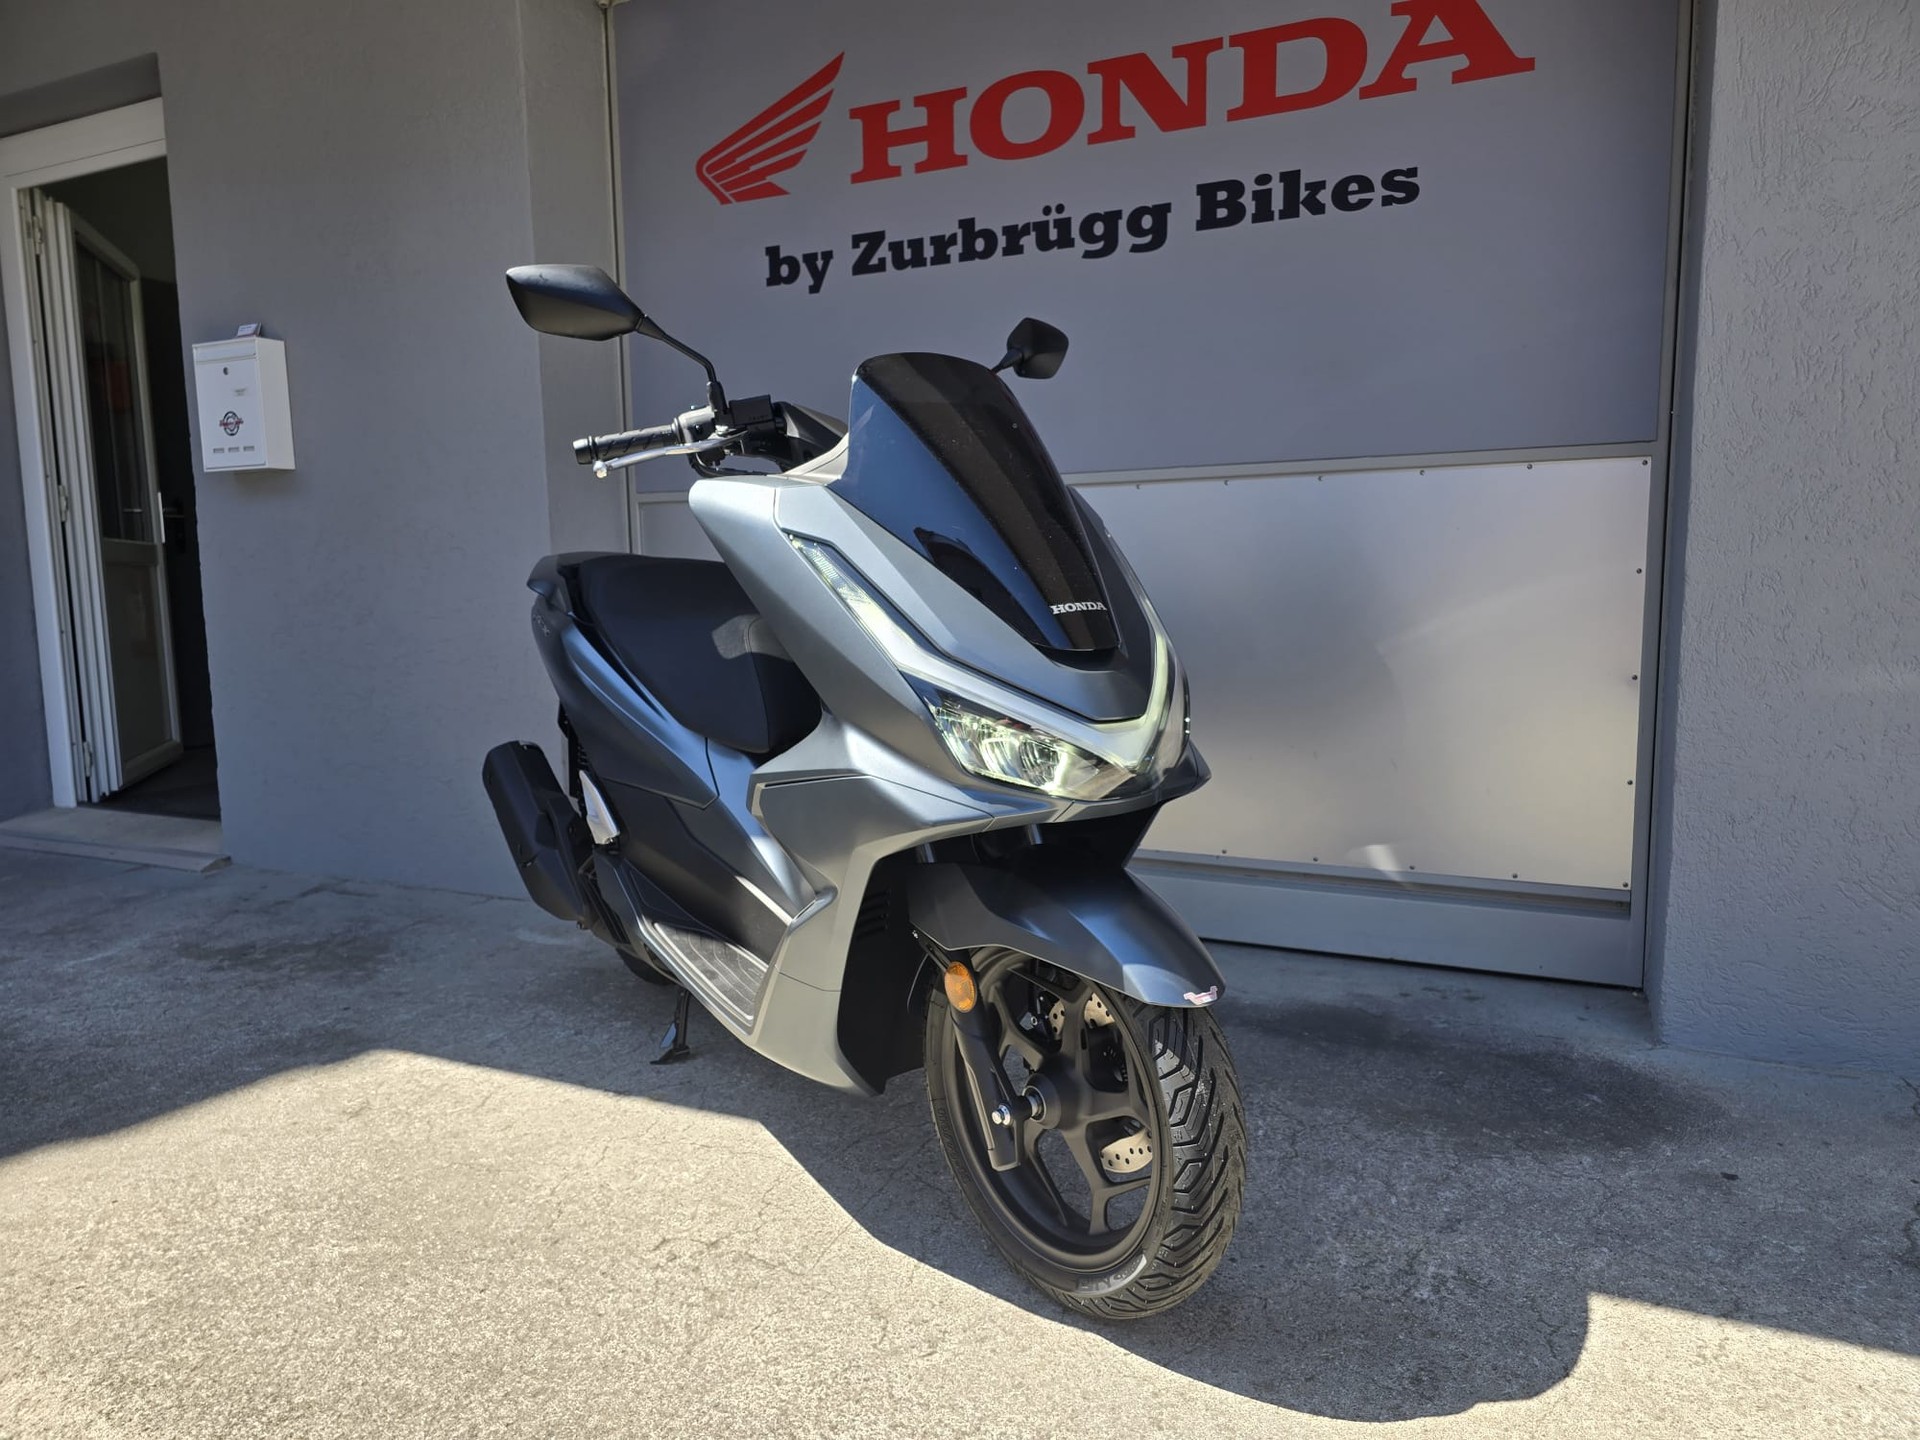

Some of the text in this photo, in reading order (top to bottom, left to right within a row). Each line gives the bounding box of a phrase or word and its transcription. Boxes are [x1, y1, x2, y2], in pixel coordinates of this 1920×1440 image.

[849, 0, 1536, 184] HONDA
[765, 165, 1420, 295] by Zurbrügg Bikes
[1049, 601, 1108, 615] HONDA
